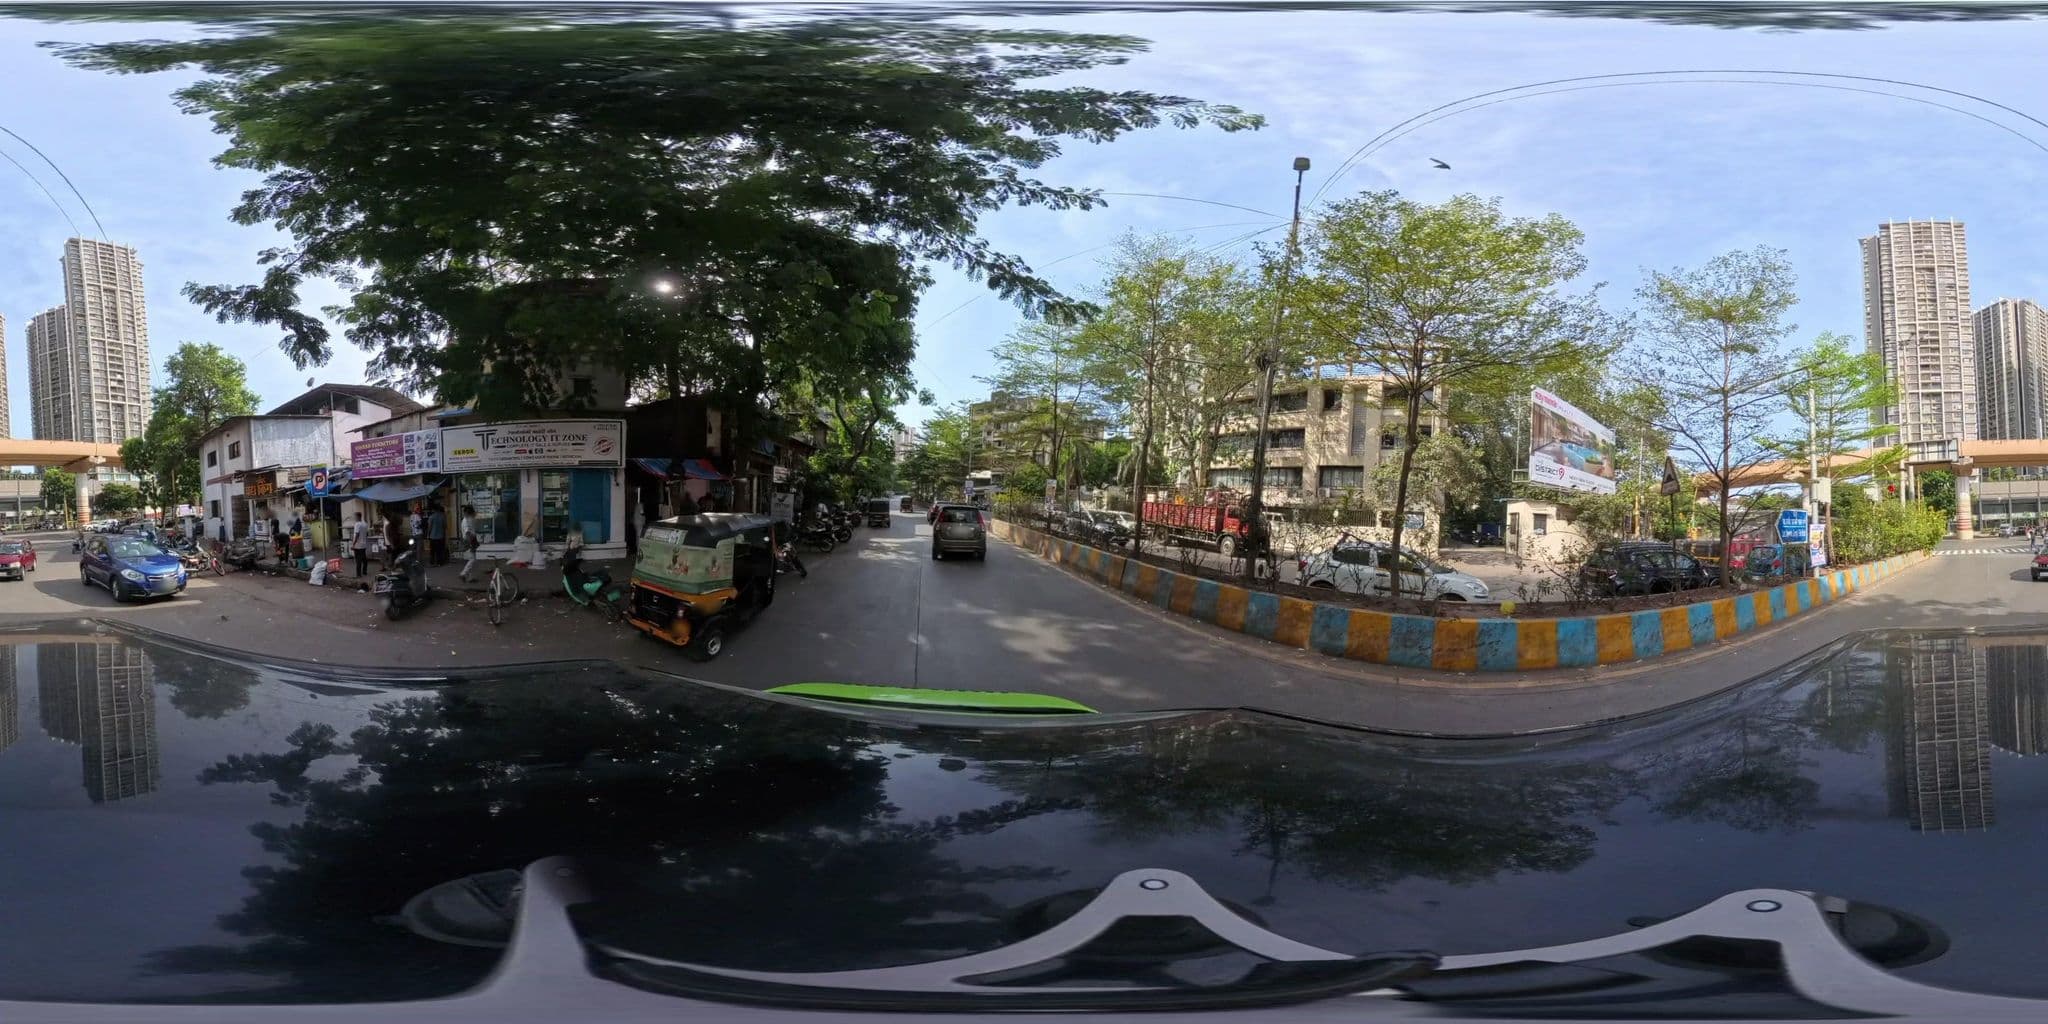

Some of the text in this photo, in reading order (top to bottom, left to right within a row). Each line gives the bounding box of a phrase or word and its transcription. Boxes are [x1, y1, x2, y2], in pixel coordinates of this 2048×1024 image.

[473, 429, 547, 451] TECHNOLOGY
[562, 433, 588, 442] ZONE
[315, 475, 324, 489] P
